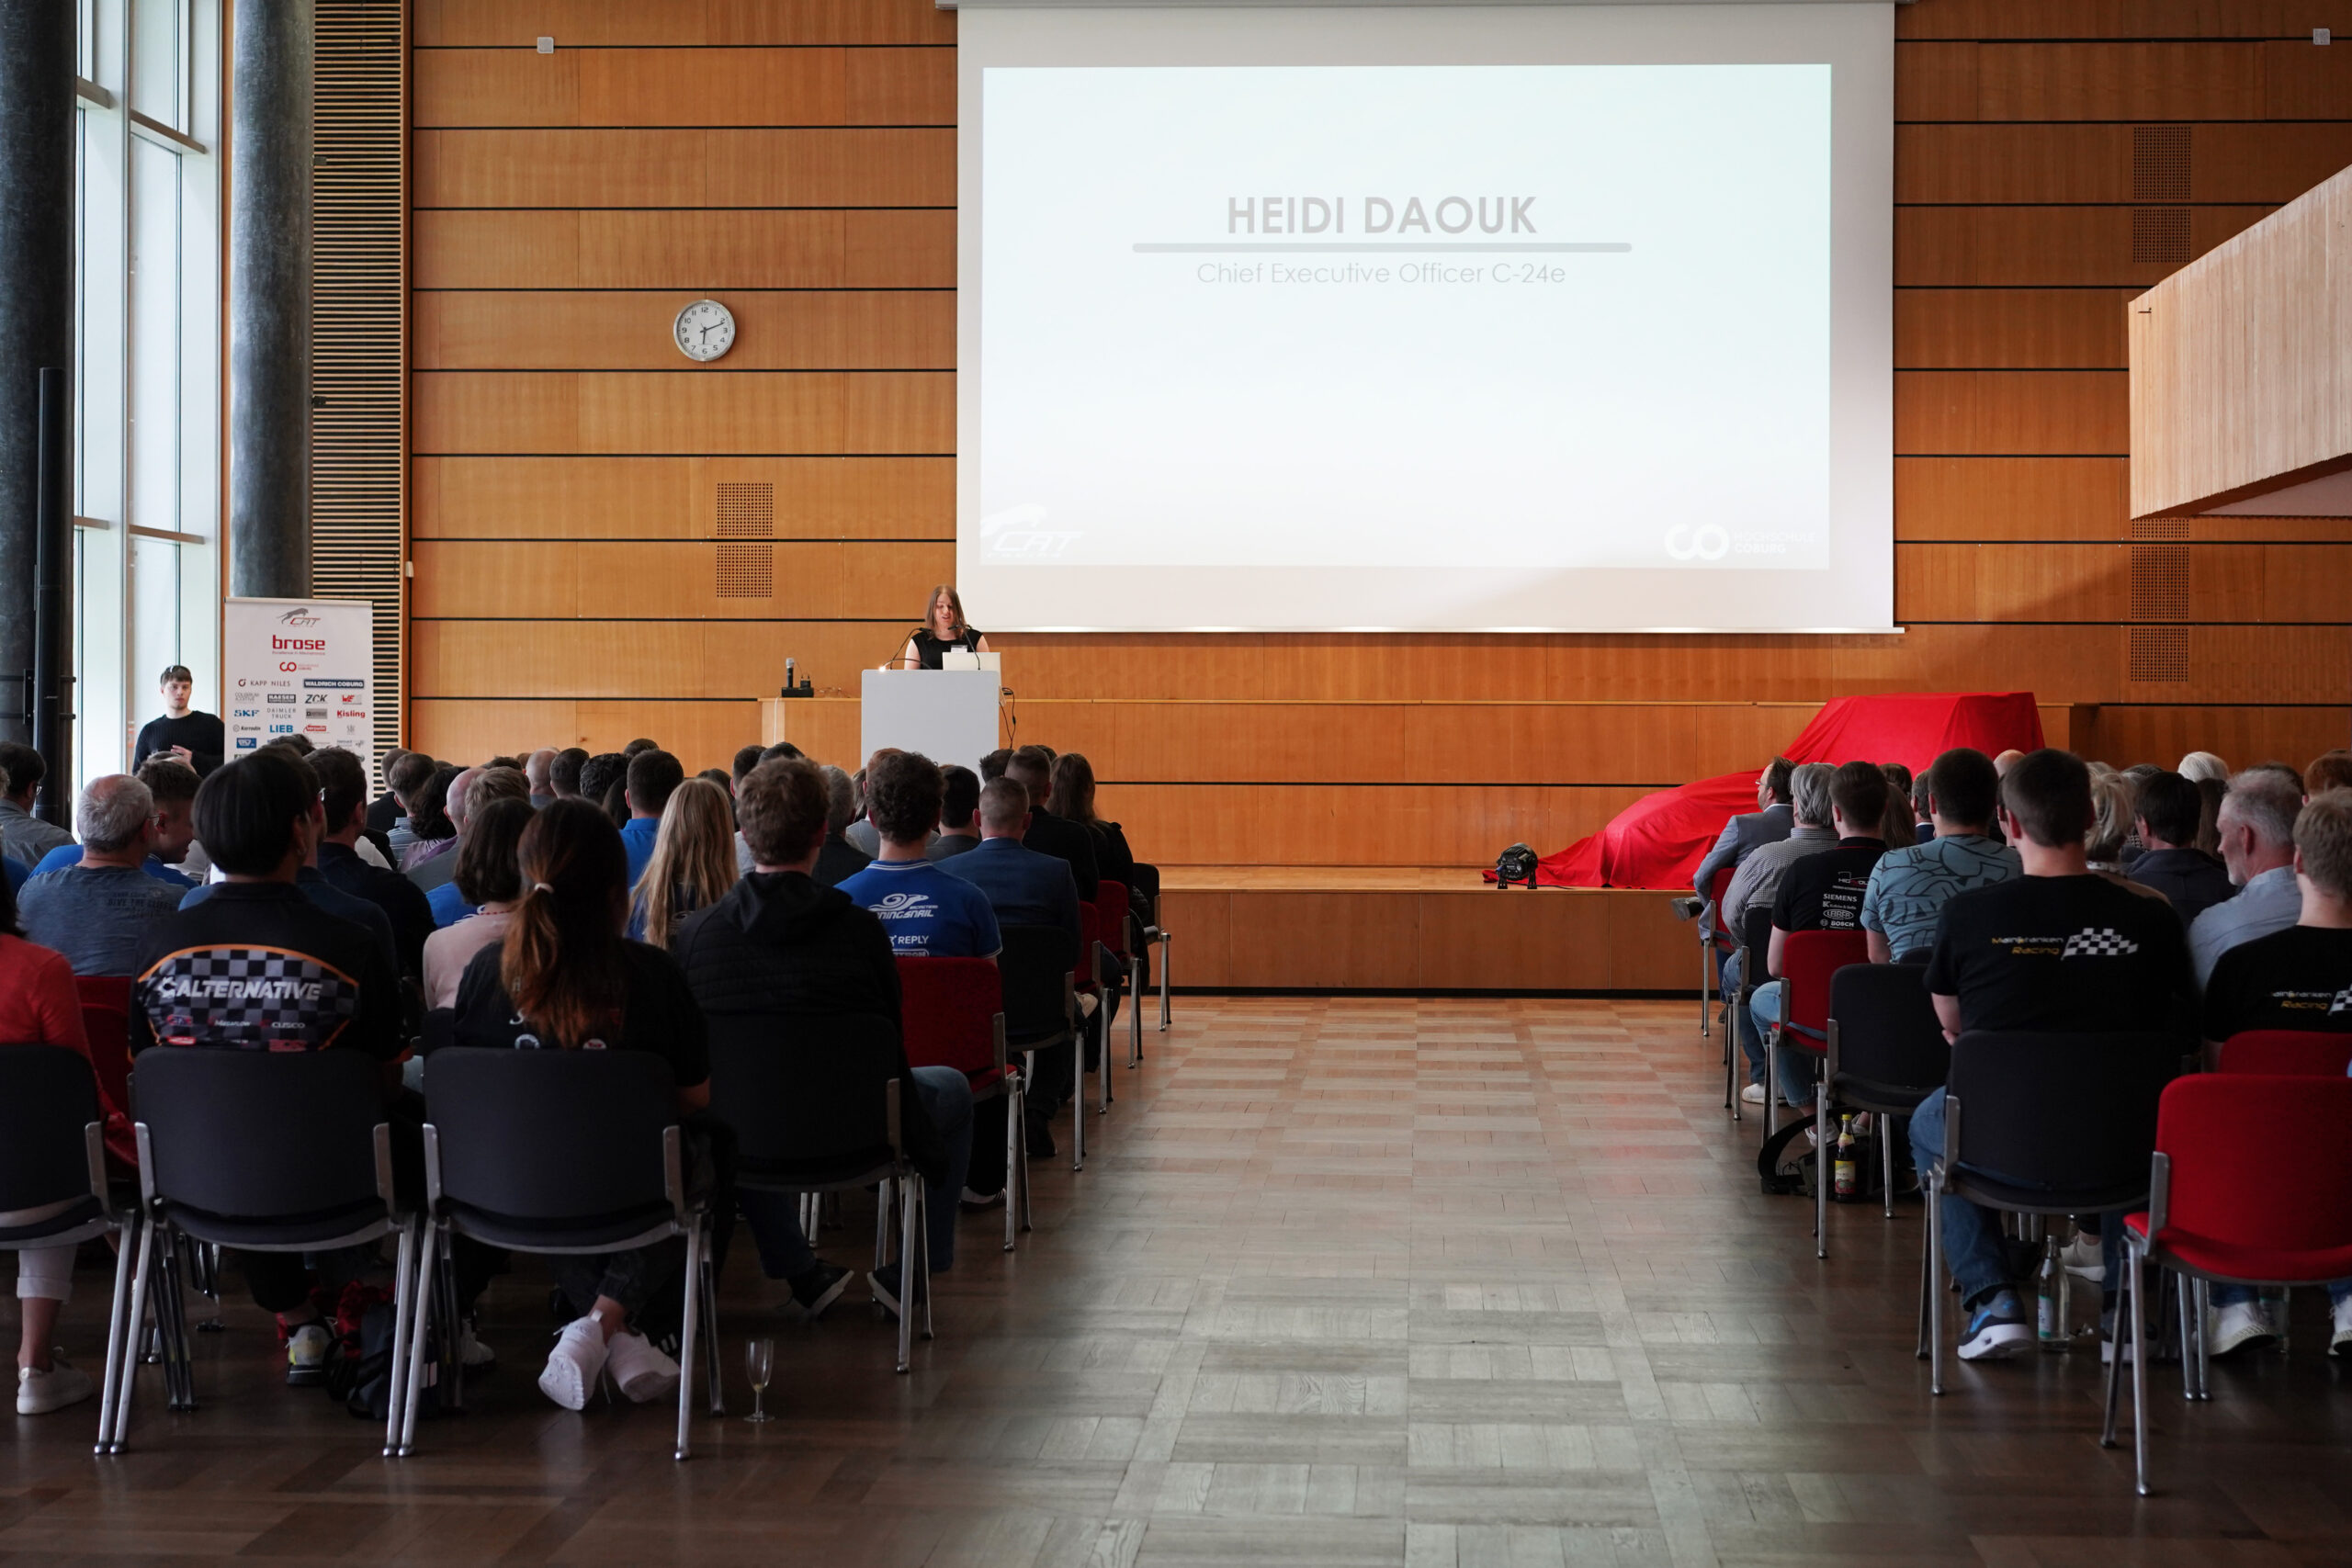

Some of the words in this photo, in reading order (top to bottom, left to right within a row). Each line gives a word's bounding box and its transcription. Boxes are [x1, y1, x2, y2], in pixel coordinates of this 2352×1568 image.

[1228, 197, 1344, 233] HEIDI
[1364, 196, 1537, 233] DAOUK
[1197, 263, 1263, 283] Chief
[1272, 263, 1390, 283] Executive
[1398, 263, 1485, 283] Officer
[1492, 263, 1566, 283] C-24e
[272, 635, 325, 650] brose
[337, 710, 366, 718] Kisling
[270, 725, 293, 733] LIEB
[1823, 894, 1858, 902] SIEMENS
[899, 935, 929, 944] REPLY
[2012, 946, 2060, 955] Racing
